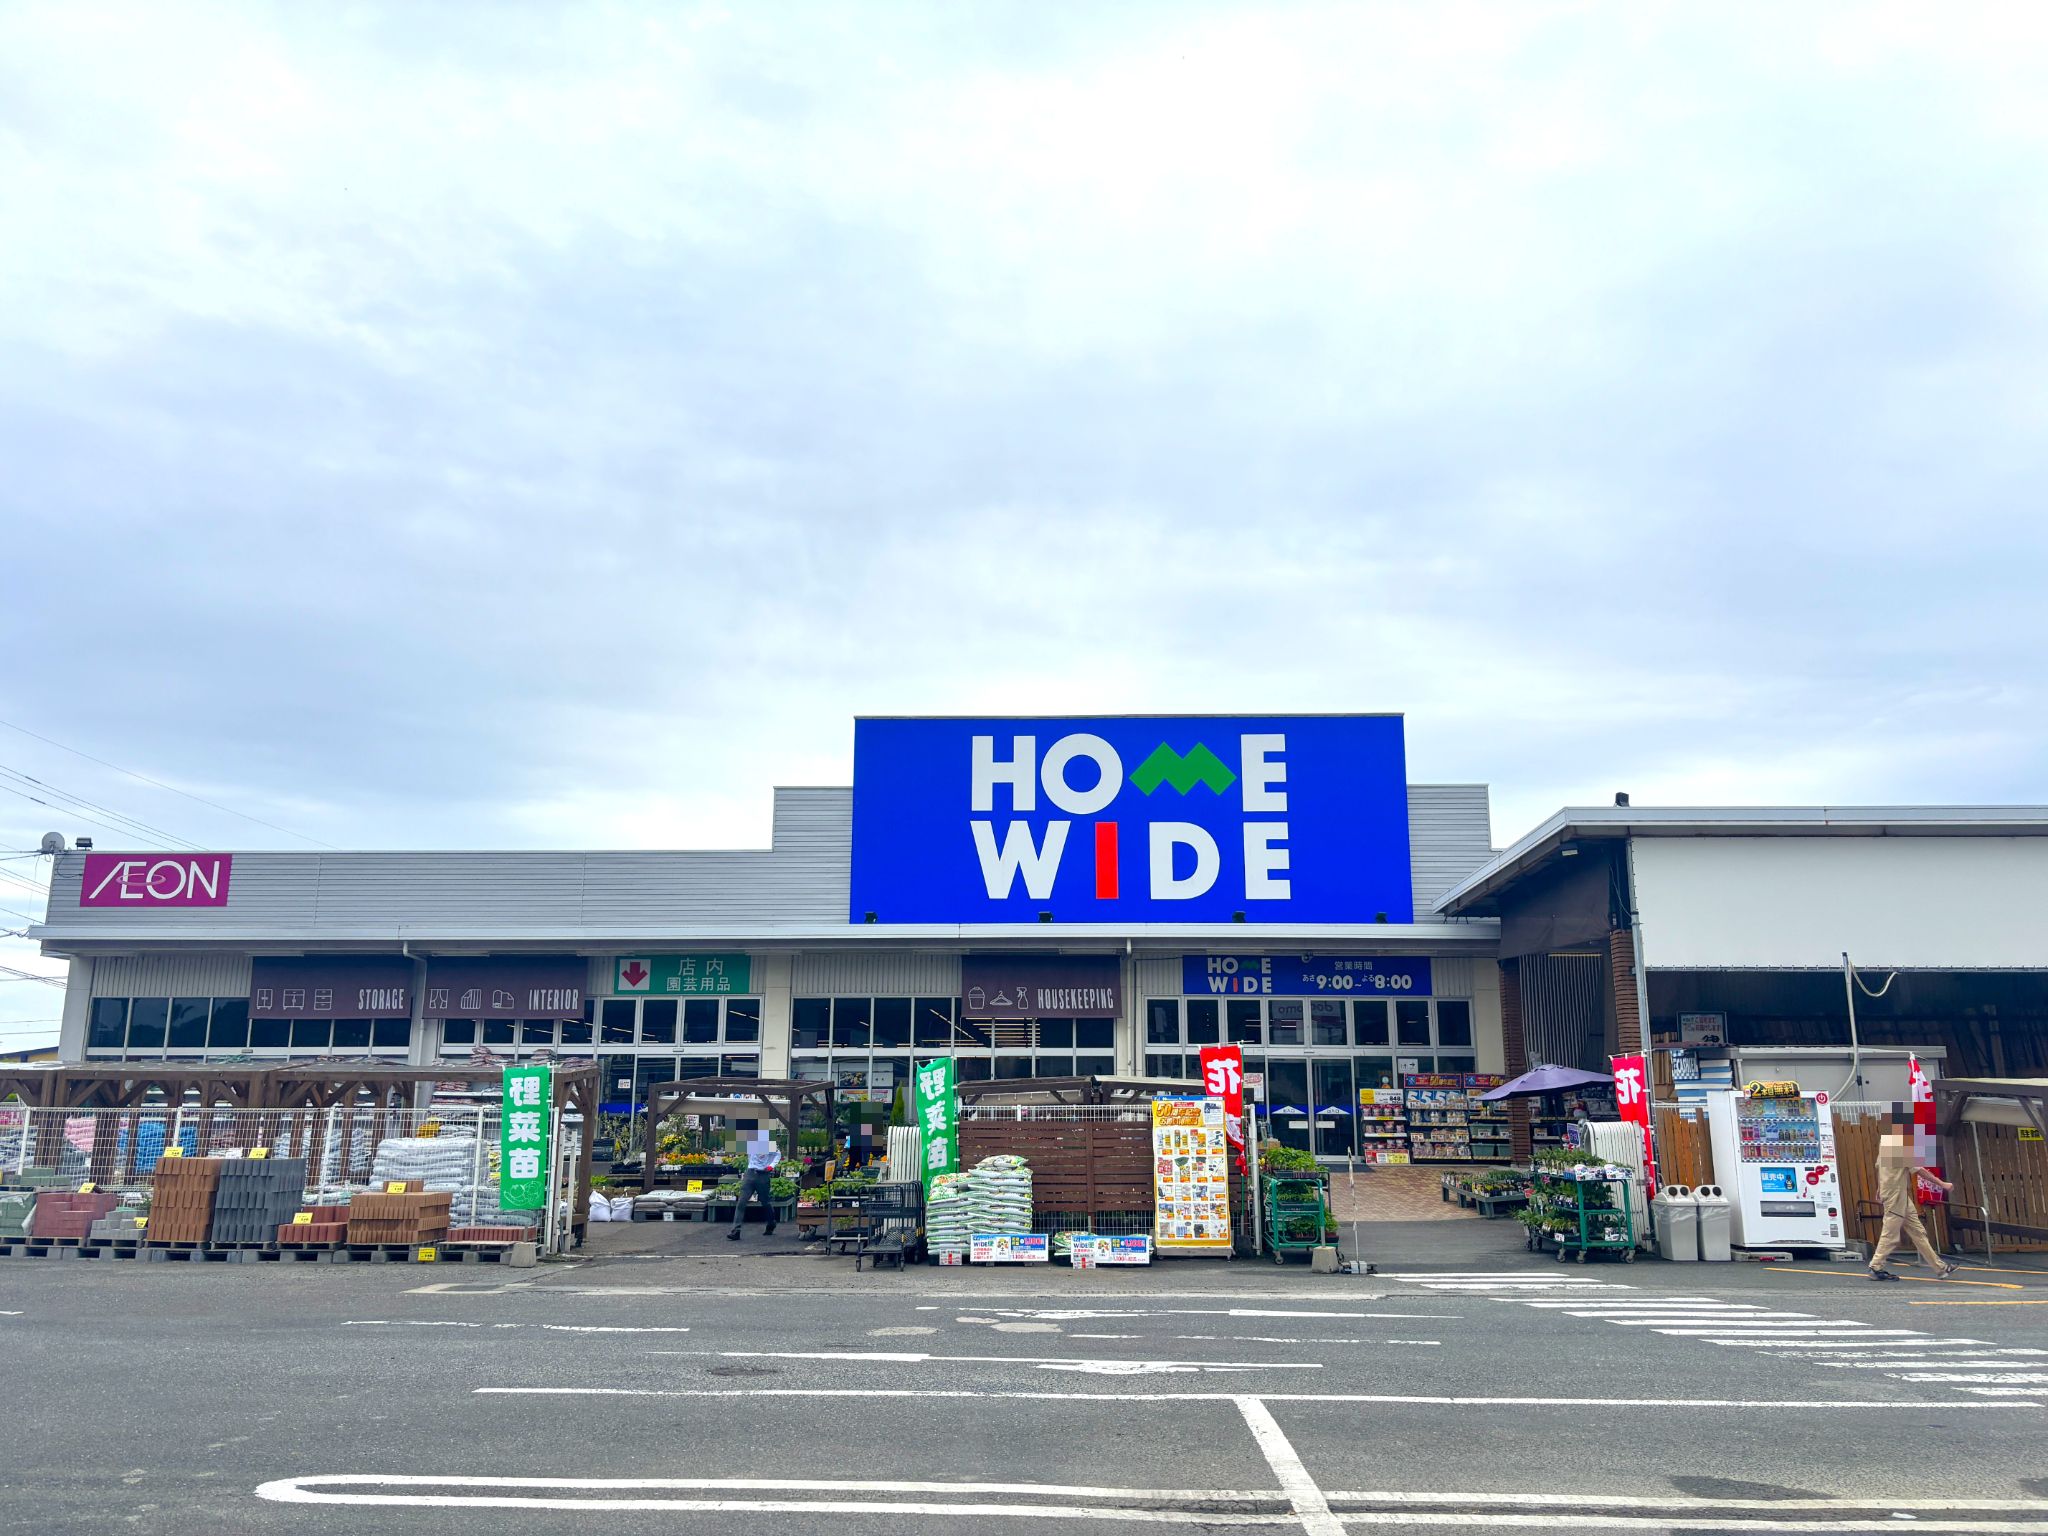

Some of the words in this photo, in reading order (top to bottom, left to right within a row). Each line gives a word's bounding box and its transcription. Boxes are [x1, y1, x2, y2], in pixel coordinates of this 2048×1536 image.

[971, 733, 1288, 815] HOME
[969, 820, 1292, 900] WIDE
[678, 957, 724, 976] 店内
[1206, 957, 1272, 974] HOME
[1334, 961, 1373, 971] 営業時間
[666, 976, 731, 992] 園芸用品
[1207, 976, 1273, 993] WIDE
[358, 988, 405, 1010] STORAGE
[528, 988, 579, 1010] INTERIOR
[1037, 987, 1114, 1010] HOUSEKEEPING
